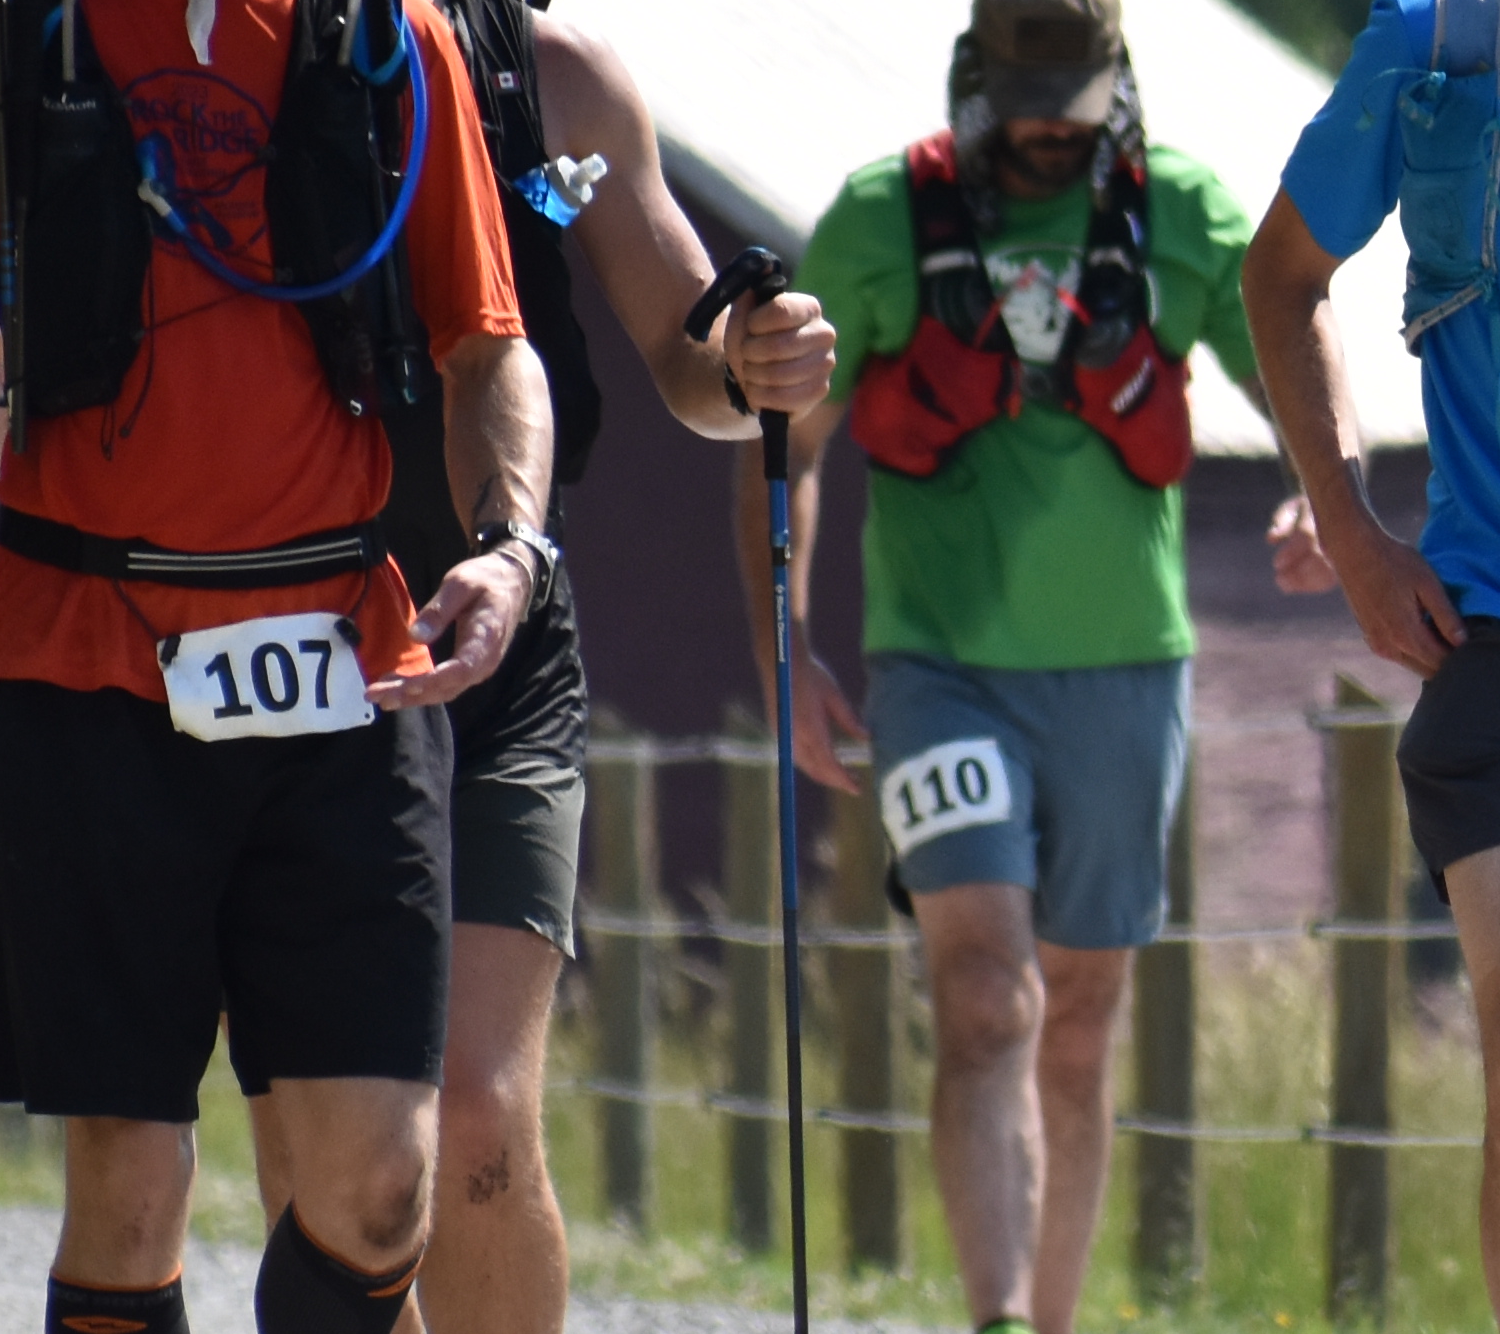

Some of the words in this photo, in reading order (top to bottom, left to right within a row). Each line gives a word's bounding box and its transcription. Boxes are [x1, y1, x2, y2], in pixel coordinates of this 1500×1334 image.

[129, 98, 209, 127] ROCK
[205, 640, 333, 719] 107
[897, 757, 990, 829] 110
